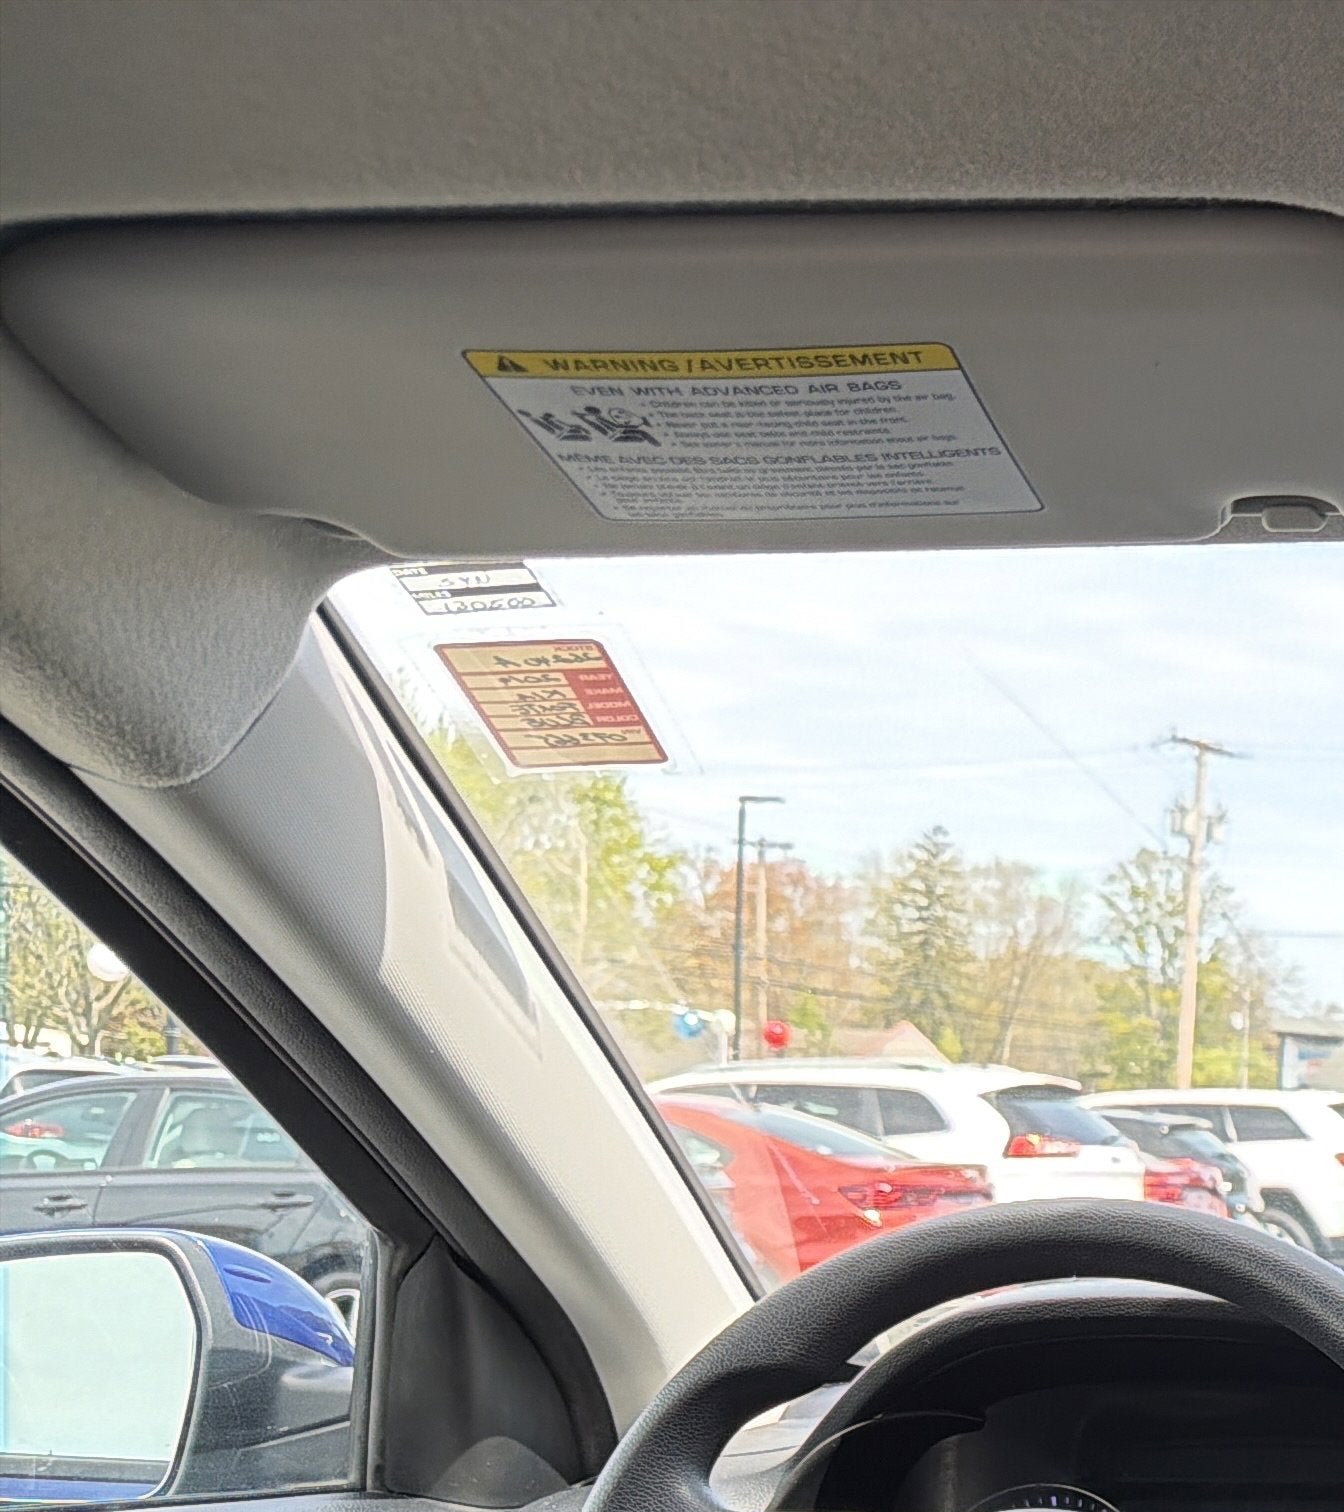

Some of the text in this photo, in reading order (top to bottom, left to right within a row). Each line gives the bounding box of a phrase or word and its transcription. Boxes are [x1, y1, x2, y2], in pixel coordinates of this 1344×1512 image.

[544, 357, 679, 373] WARNING
[570, 380, 902, 397] EVEN WITH ADVANCED AIR BAGS
